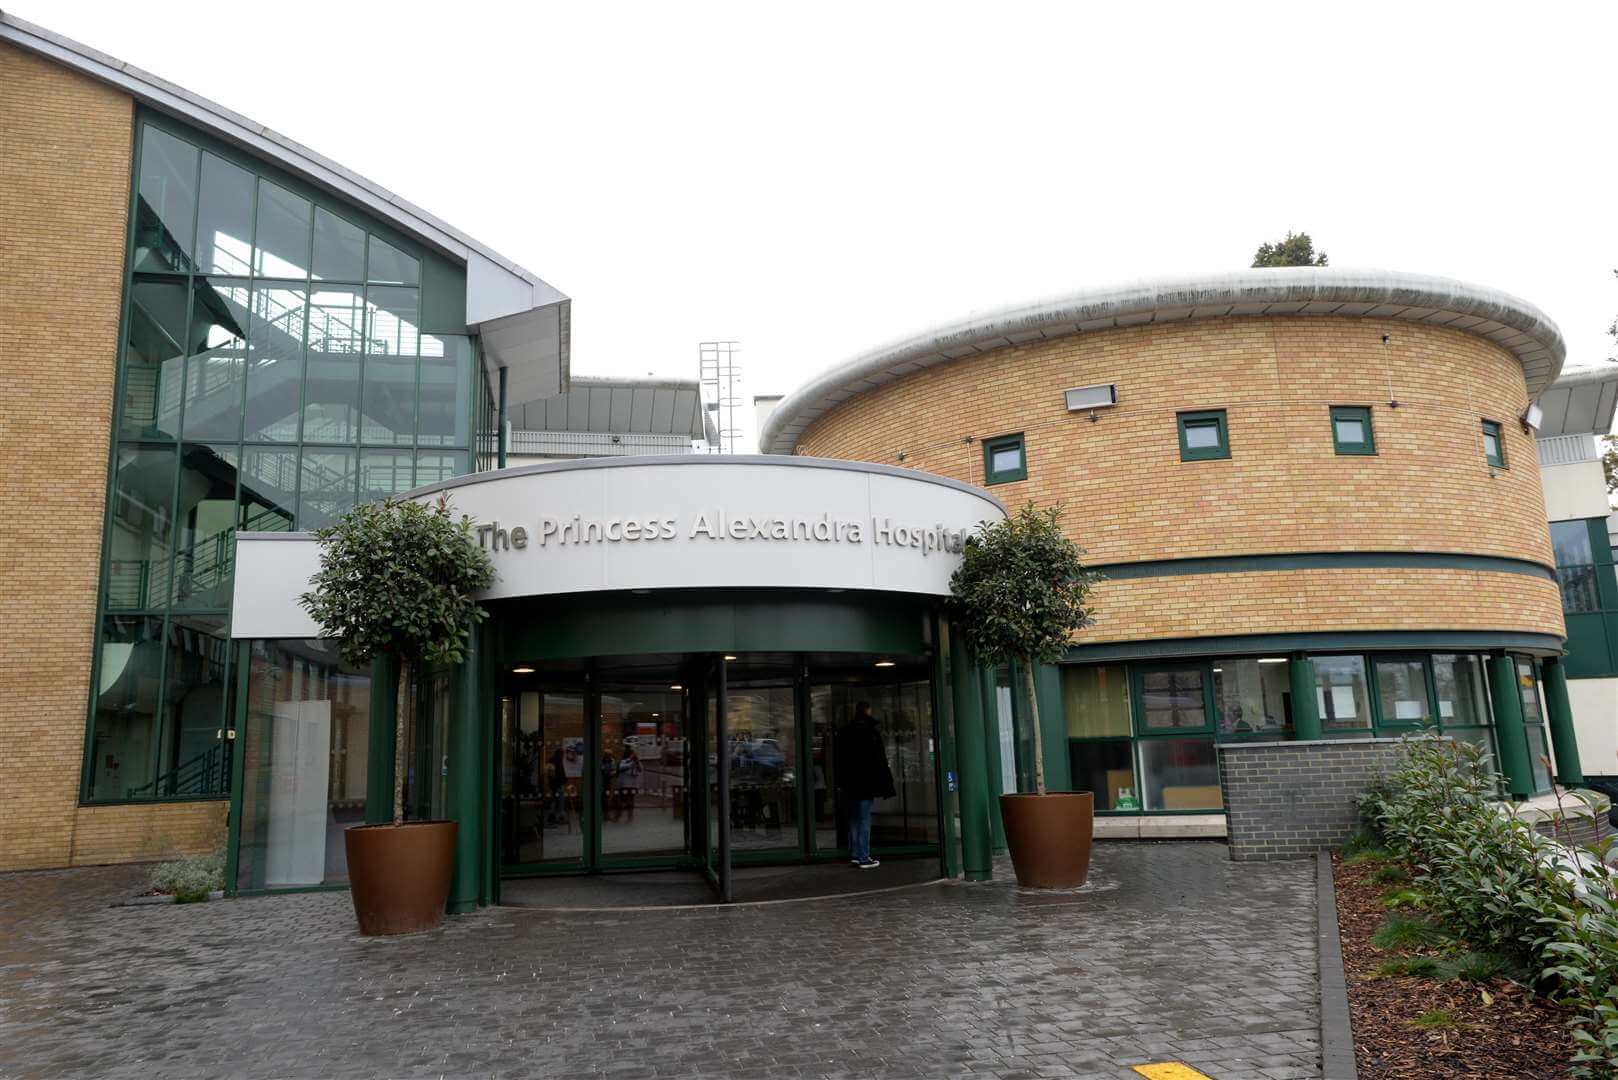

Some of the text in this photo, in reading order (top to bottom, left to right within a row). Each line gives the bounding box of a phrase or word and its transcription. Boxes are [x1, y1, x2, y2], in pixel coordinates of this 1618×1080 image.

[476, 508, 967, 556] The Princess Alexandra Hospital
